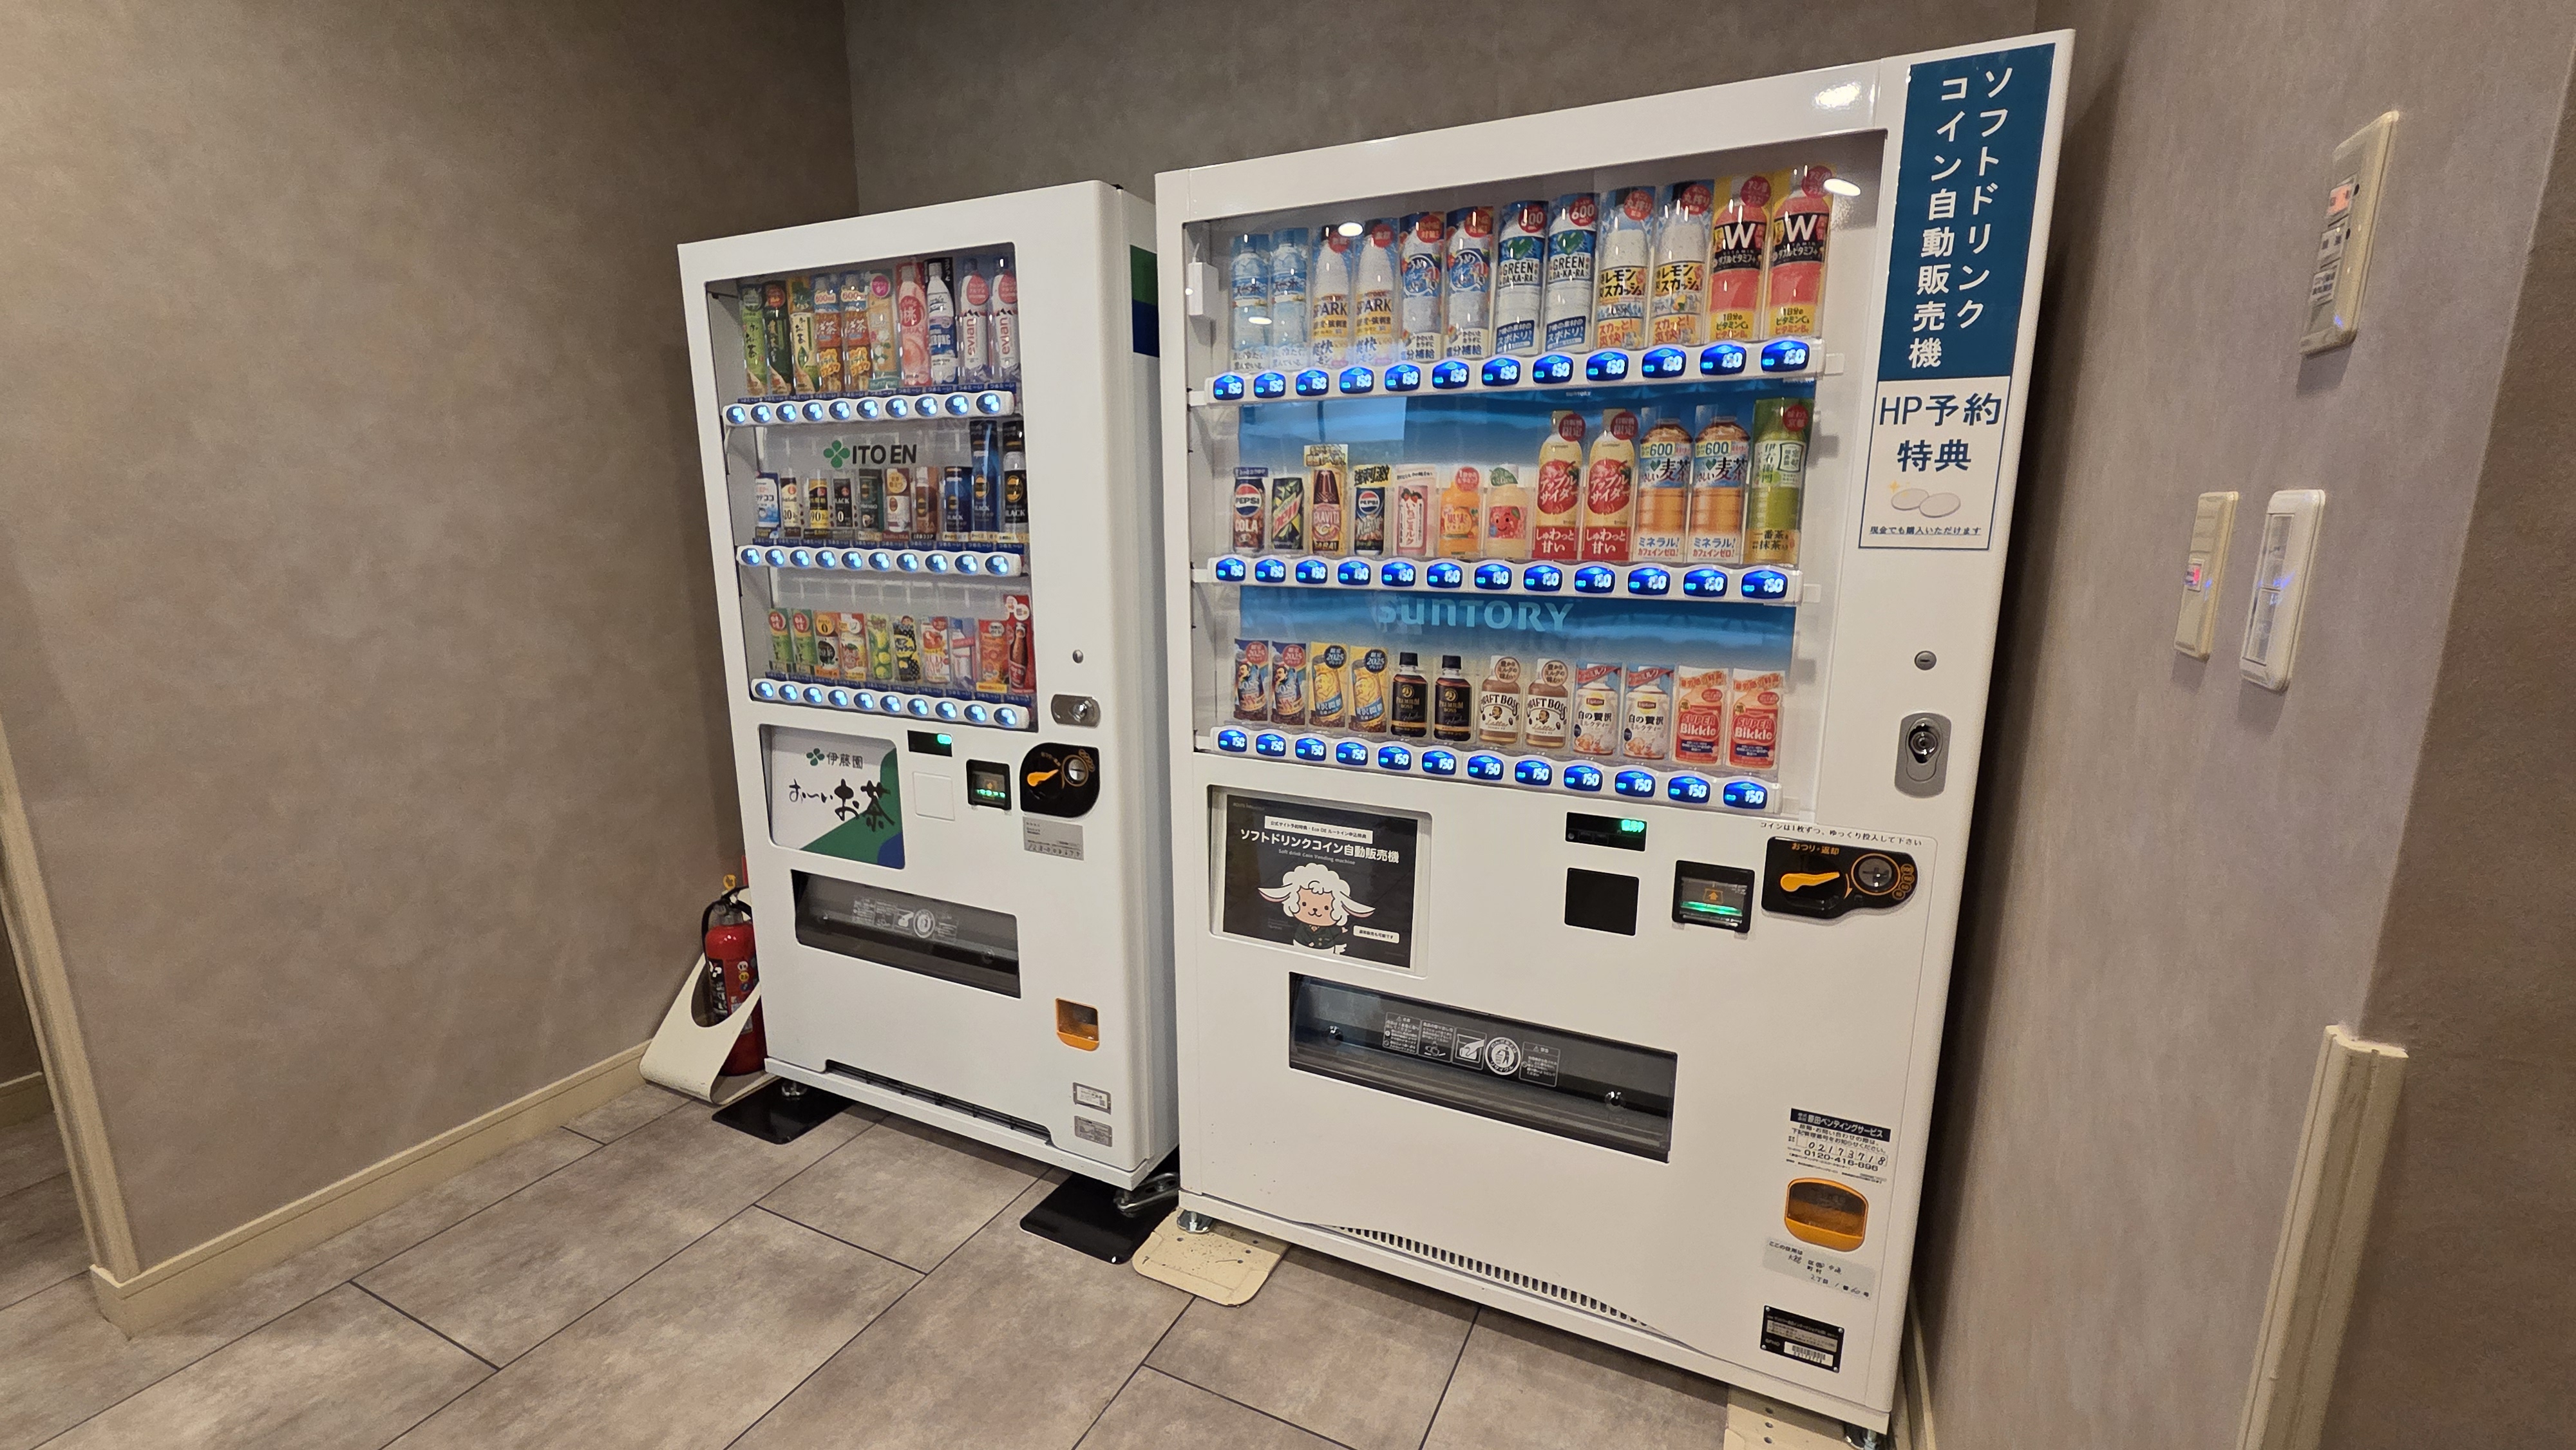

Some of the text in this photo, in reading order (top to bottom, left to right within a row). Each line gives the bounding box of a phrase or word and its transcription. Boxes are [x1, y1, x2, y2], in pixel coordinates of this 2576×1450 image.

[1956, 67, 2012, 330] ソフトドリンク
[1571, 205, 1595, 220] 600
[1786, 214, 1817, 243] W
[1908, 78, 1968, 368] コイン自動販売機
[1724, 223, 1756, 250] W
[1502, 261, 1534, 275] GREEN
[1553, 256, 1586, 269] GREEN
[1605, 268, 1636, 283] レモン
[1662, 264, 1694, 279] レモン
[967, 319, 976, 356] evian
[1000, 317, 1010, 355] evian
[1879, 393, 2002, 426] HP予約
[853, 444, 917, 465] ITO EN
[1650, 443, 1673, 457] 600
[1707, 442, 1729, 455] 600
[1897, 439, 1971, 473] 特典
[1660, 458, 1691, 482] 麦茶
[1716, 457, 1748, 482] 麦茶
[1235, 520, 1258, 533] COLA
[1406, 502, 1416, 545] いちごミルク
[1536, 528, 1575, 541] しゅわっと
[1586, 528, 1626, 541] しゅわっと
[1542, 541, 1566, 554] 甘い
[1592, 541, 1616, 554] 甘い
[1638, 536, 1680, 548] ミネラル!
[1693, 537, 1736, 549] ミネラル!
[1638, 548, 1679, 558] カフェインゼロ!
[1692, 549, 1736, 558] カフェインゼロ!
[1378, 596, 1573, 632] SUNTORY
[1327, 653, 1344, 661] 2025
[1367, 657, 1385, 666] 2025
[1578, 711, 1613, 722] 白の贅沢
[1629, 714, 1663, 726] 白の贅沢
[1682, 714, 1715, 726] SUPER
[1738, 718, 1771, 730] SUPER
[1271, 740, 1283, 751] 150
[1311, 746, 1323, 756] 150
[827, 752, 863, 769] 伊藤園
[1352, 748, 1365, 760] 150
[1395, 753, 1408, 765] 150
[1439, 758, 1454, 770] 150
[1485, 763, 1501, 775] 150
[1532, 767, 1549, 780] 150
[1582, 773, 1599, 786] 150
[1634, 778, 1652, 792] 150
[1689, 784, 1706, 798] 150
[1744, 790, 1763, 804] 150
[1760, 822, 1922, 846] コインは1枚ずつ、ゆっくり投入して下さい
[1240, 829, 1400, 863] ソフトドリンクコイン自動販売機
[1792, 842, 1840, 855] おつり・返却
